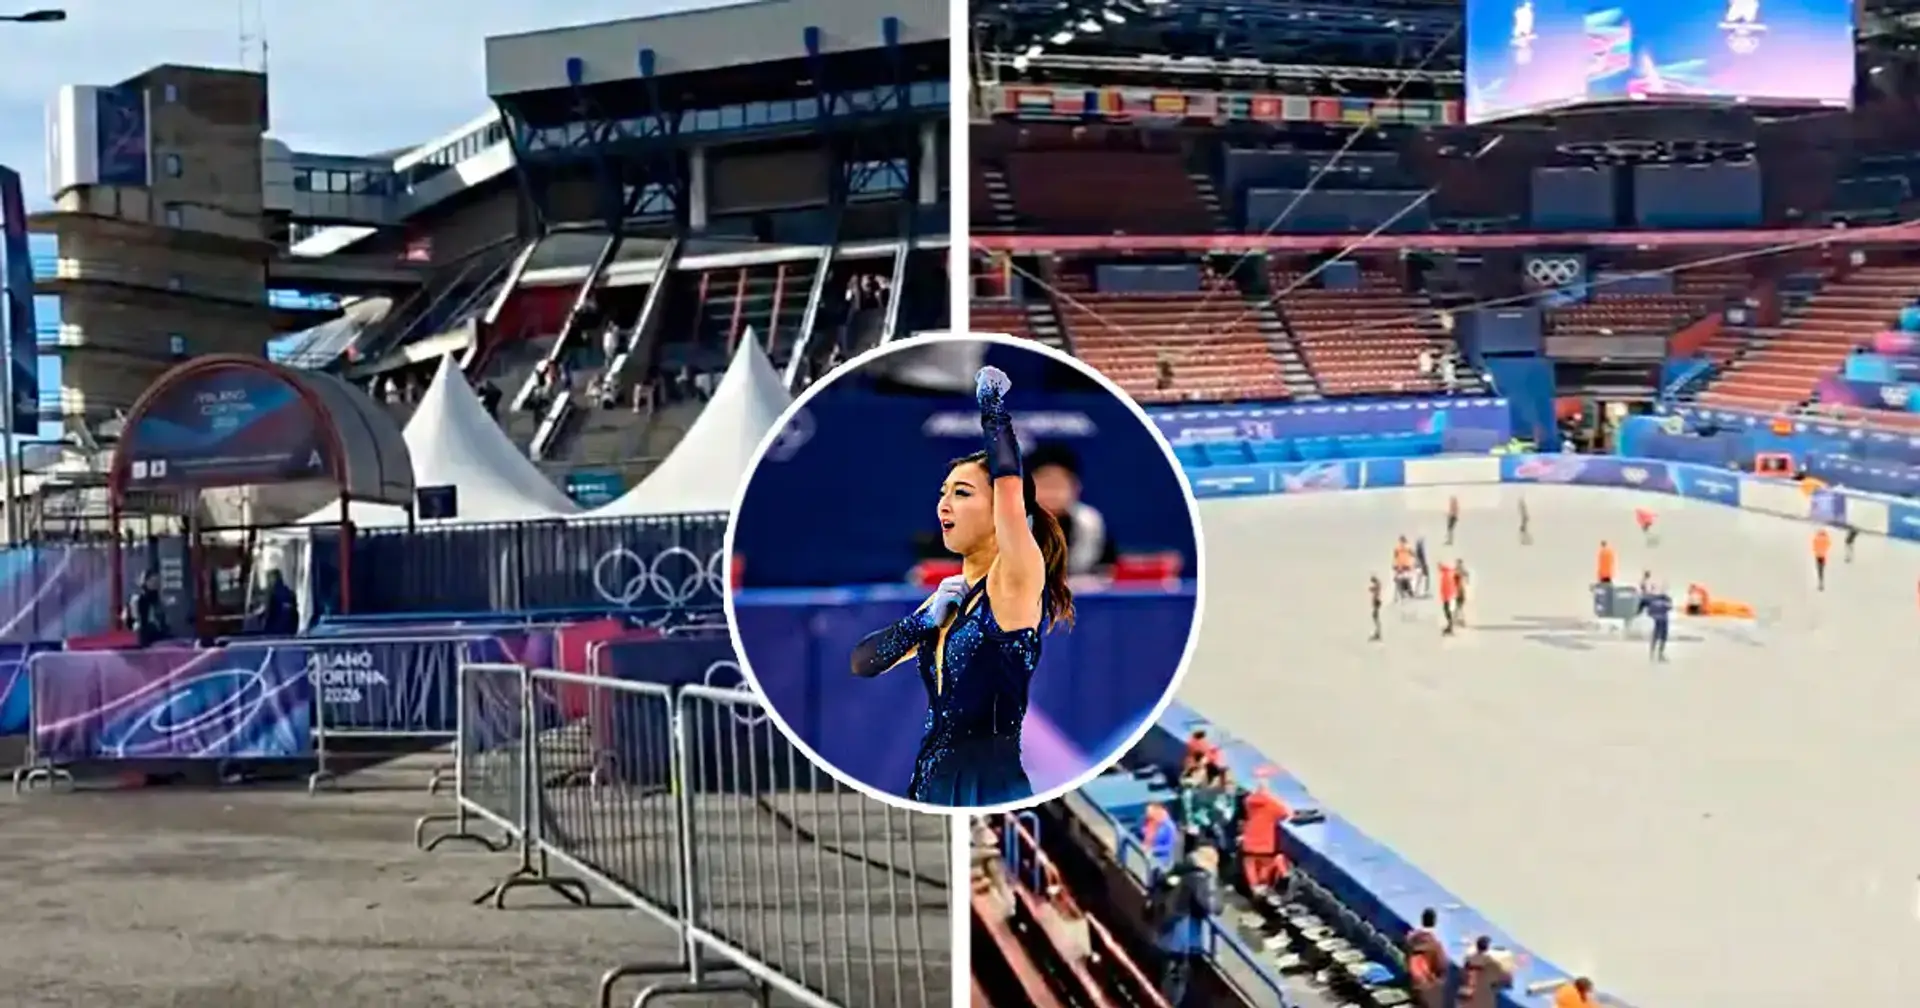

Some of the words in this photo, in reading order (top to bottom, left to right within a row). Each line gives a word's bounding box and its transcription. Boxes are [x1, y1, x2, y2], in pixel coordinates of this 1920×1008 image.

[308, 450, 323, 469] A
[307, 650, 373, 669] MLANO
[308, 669, 388, 687] CORTINA
[324, 686, 363, 703] 2026
